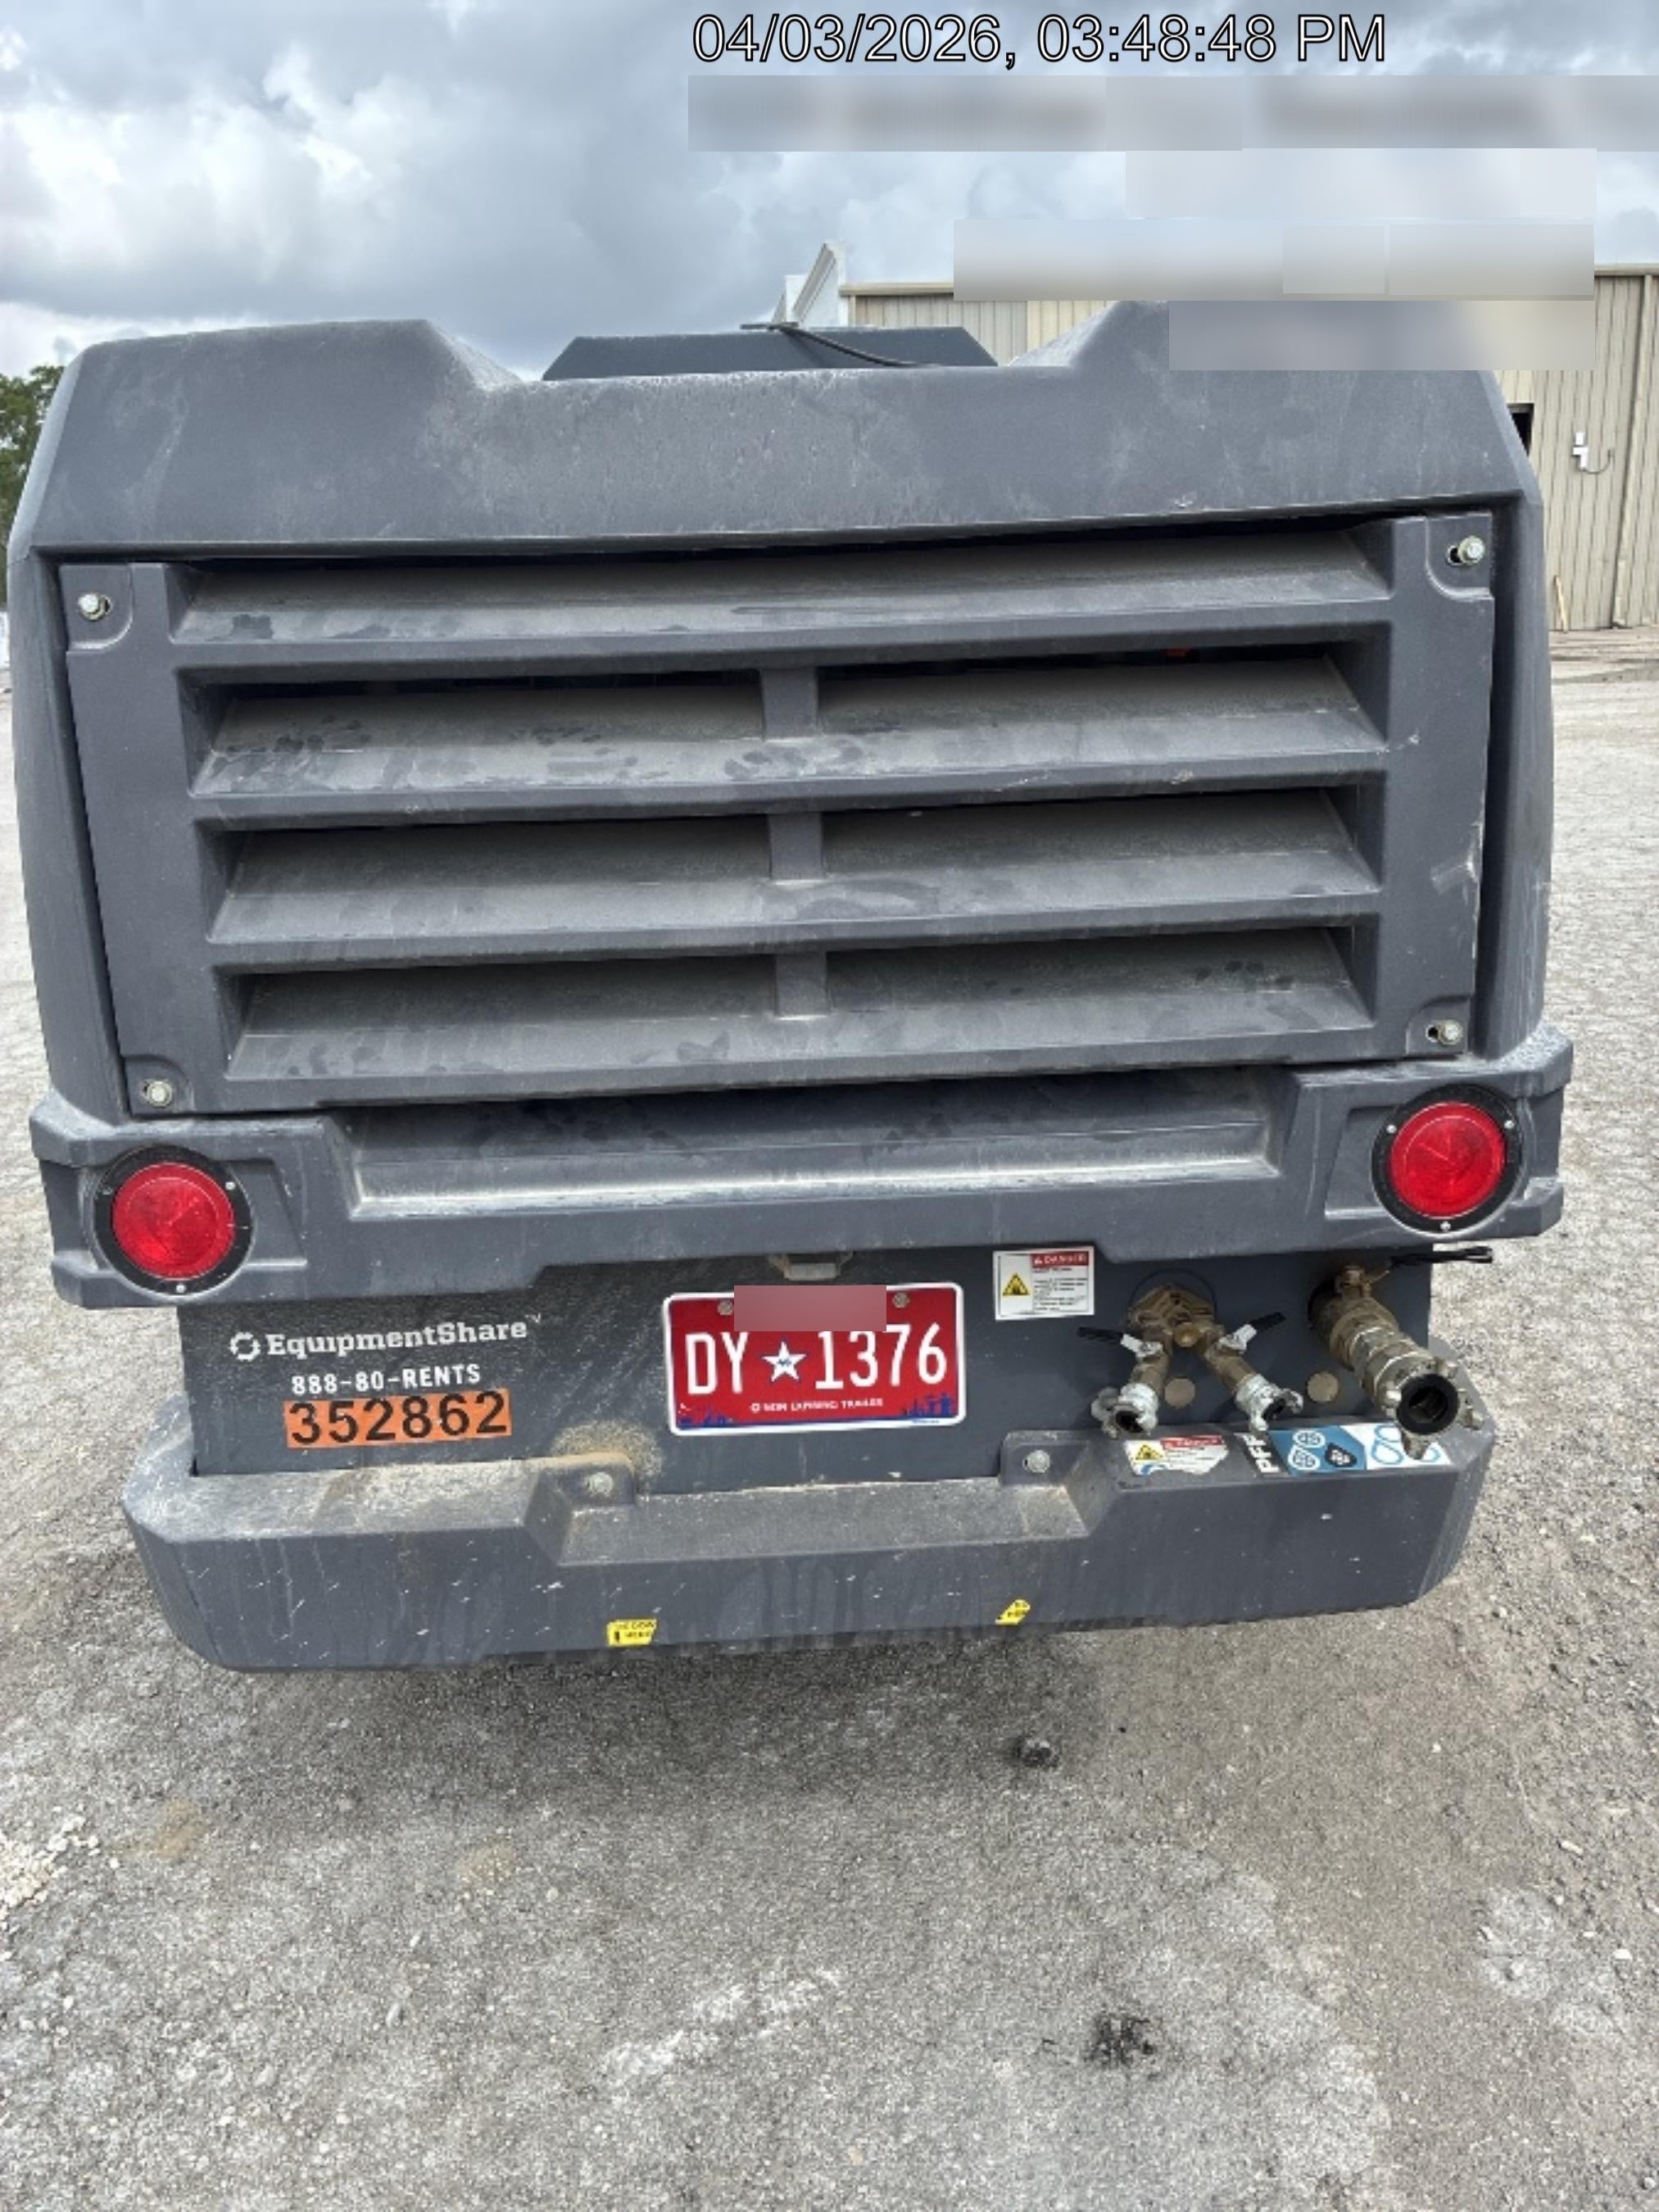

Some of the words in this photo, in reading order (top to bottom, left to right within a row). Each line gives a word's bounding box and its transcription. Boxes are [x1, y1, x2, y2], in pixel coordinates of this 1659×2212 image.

[264, 1321, 528, 1360] EquipmentShare
[685, 1330, 750, 1395] DY
[814, 1321, 947, 1390] 1376
[291, 1363, 481, 1395] 888-80-RENTS
[288, 1390, 507, 1444] 352862
